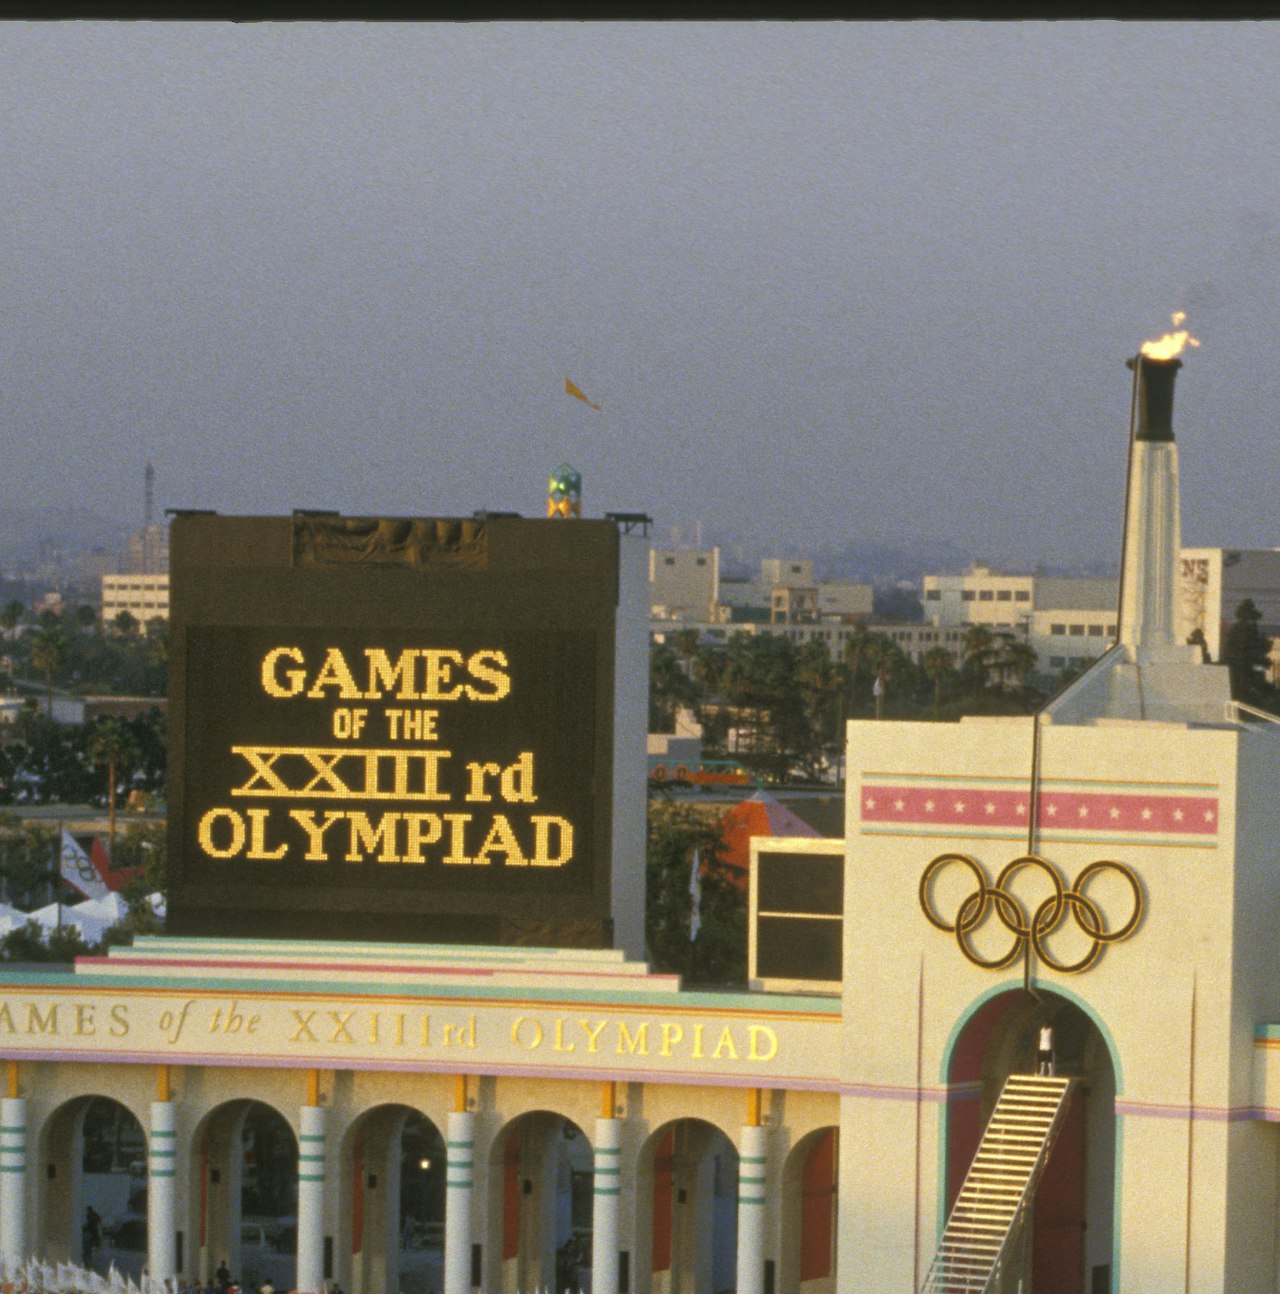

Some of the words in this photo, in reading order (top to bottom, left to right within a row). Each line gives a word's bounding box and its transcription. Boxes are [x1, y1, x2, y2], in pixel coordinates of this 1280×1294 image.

[261, 646, 511, 702] GAMES
[333, 708, 368, 739] OF
[385, 708, 439, 741] THE
[231, 745, 452, 801] XXIII
[465, 751, 539, 803] rd
[197, 806, 575, 867] OLYMPIAD
[158, 999, 196, 1045] of
[208, 999, 261, 1035] the
[510, 1015, 779, 1062] OLYMPIAD
